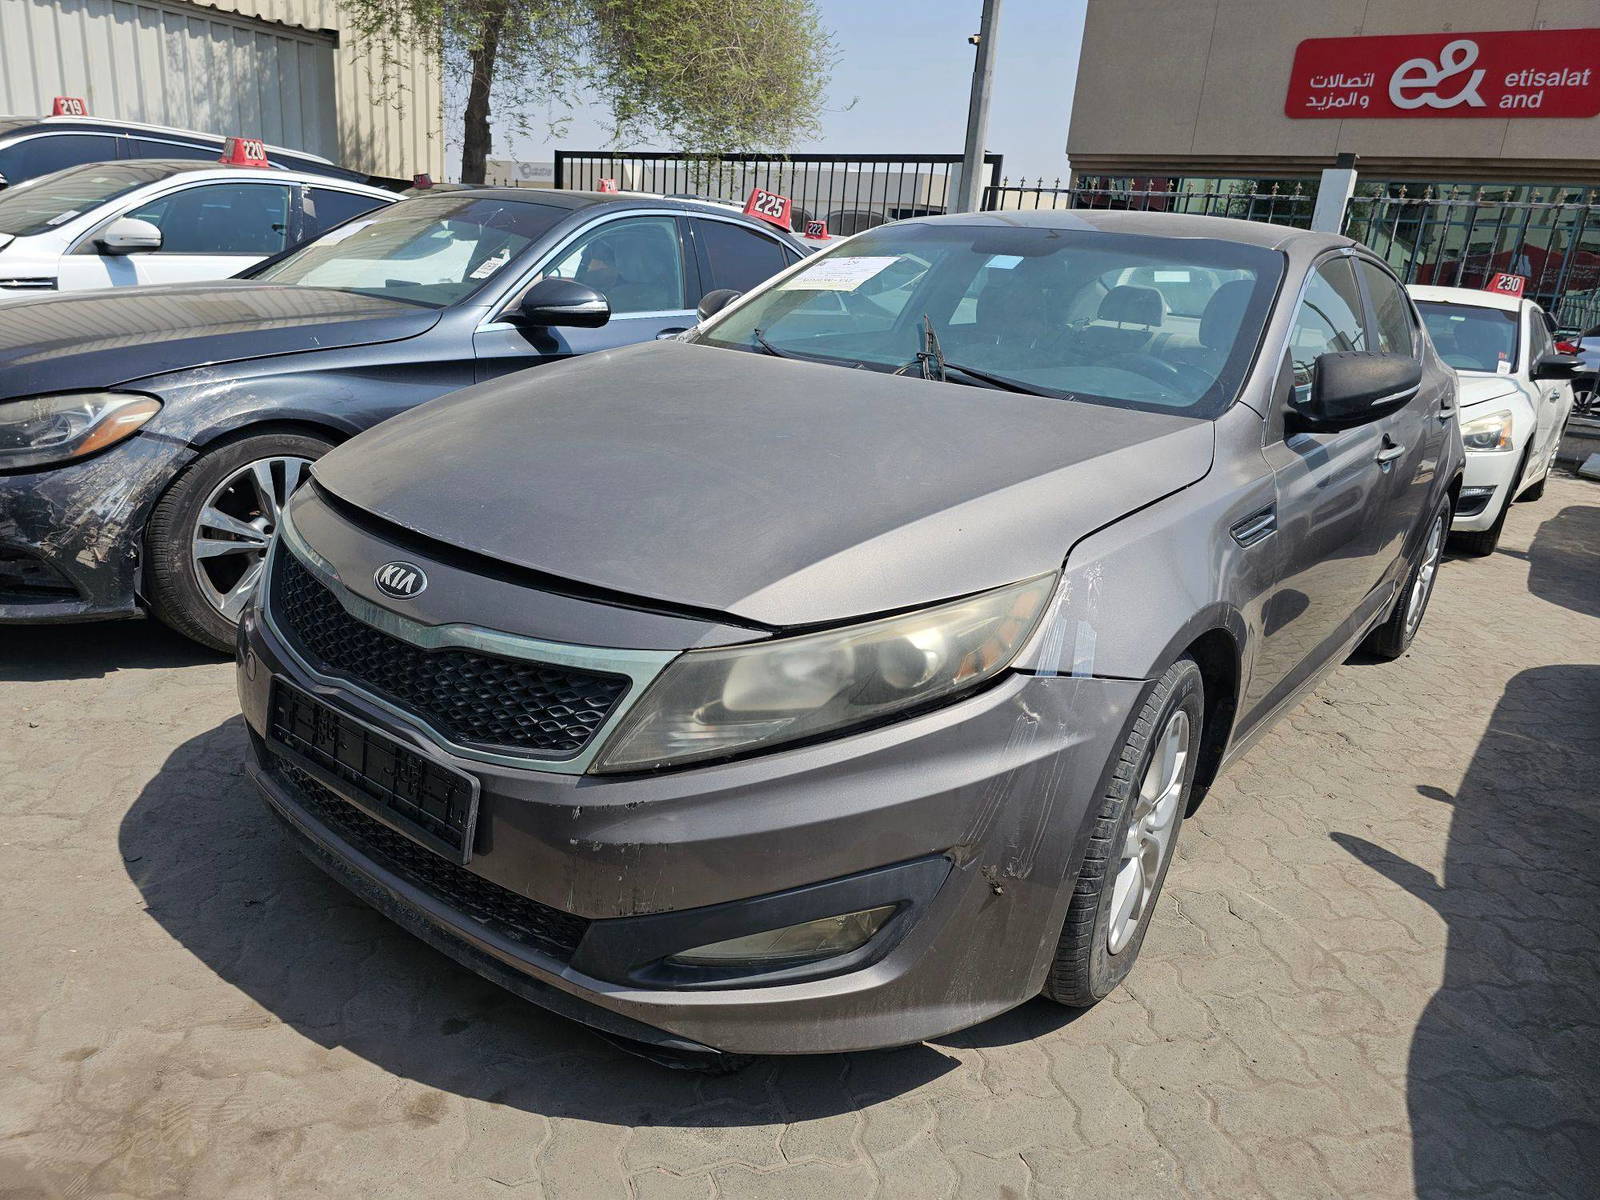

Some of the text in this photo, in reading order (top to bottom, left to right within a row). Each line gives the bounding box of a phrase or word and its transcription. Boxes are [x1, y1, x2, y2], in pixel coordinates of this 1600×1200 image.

[1310, 72, 1375, 89] اتصالات
[1504, 68, 1592, 87] etisalat
[61, 99, 83, 115] 219
[1498, 90, 1544, 109] and
[243, 140, 264, 161] 220
[754, 192, 786, 218] 225
[808, 223, 823, 236] 222
[1497, 275, 1521, 292] 230
[379, 564, 417, 594] KIA
